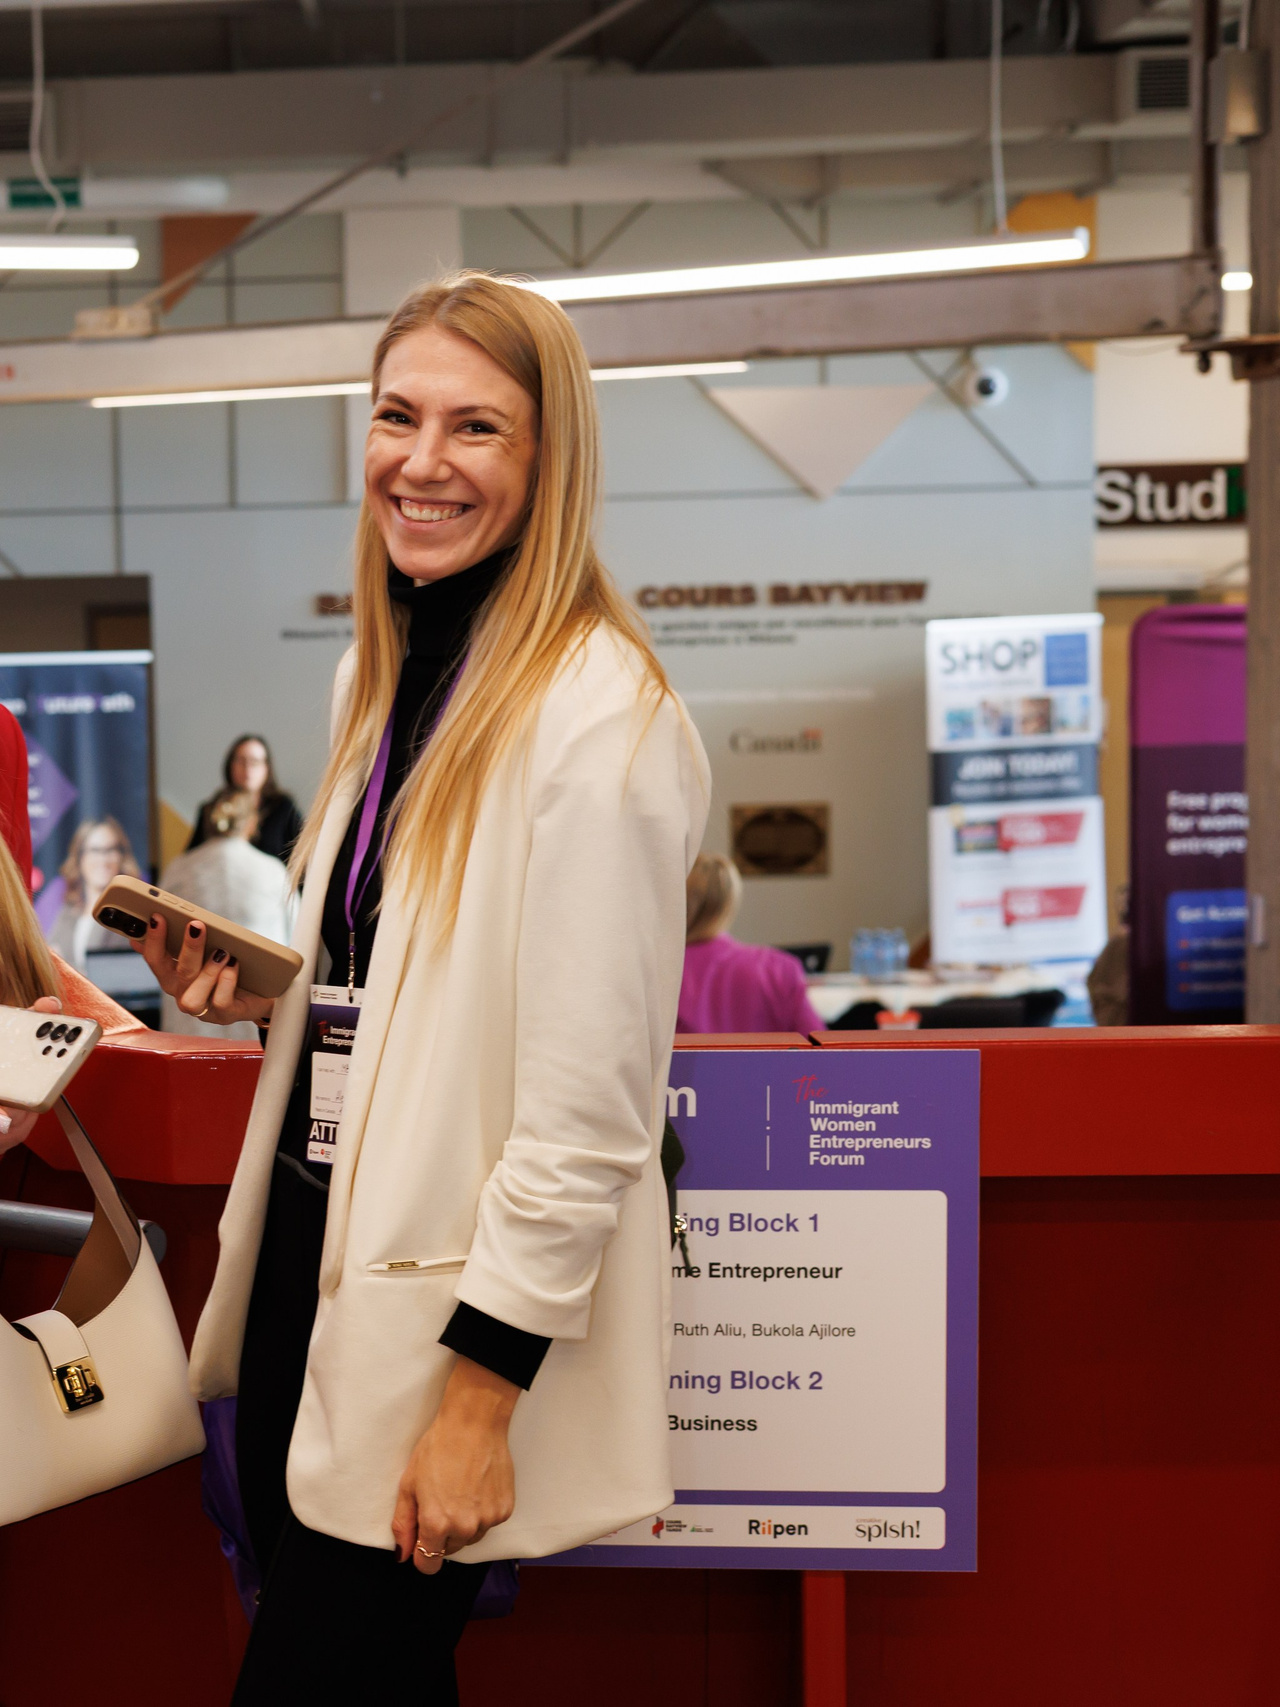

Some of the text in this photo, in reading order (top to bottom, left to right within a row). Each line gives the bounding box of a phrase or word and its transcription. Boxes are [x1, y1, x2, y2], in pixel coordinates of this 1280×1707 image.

[636, 579, 928, 608] COURS BAYVIEW
[939, 638, 1038, 675] SHOP
[1167, 791, 1207, 810] Free
[1167, 812, 1193, 833] for
[792, 1074, 830, 1104] The
[809, 1100, 899, 1118] Immigrant
[810, 1117, 877, 1132] Women
[809, 1134, 932, 1152] Entrepreneurs
[809, 1151, 865, 1166] Forum
[729, 1213, 800, 1233] Block
[809, 1213, 819, 1233] 1
[708, 1262, 843, 1282] Entrepreneur
[673, 1322, 857, 1341] Ruth Aliu, Bukola Ajilore
[669, 1370, 824, 1395] ning Block 2
[667, 1415, 759, 1432] Business
[748, 1518, 922, 1543] Riipen splsh!
